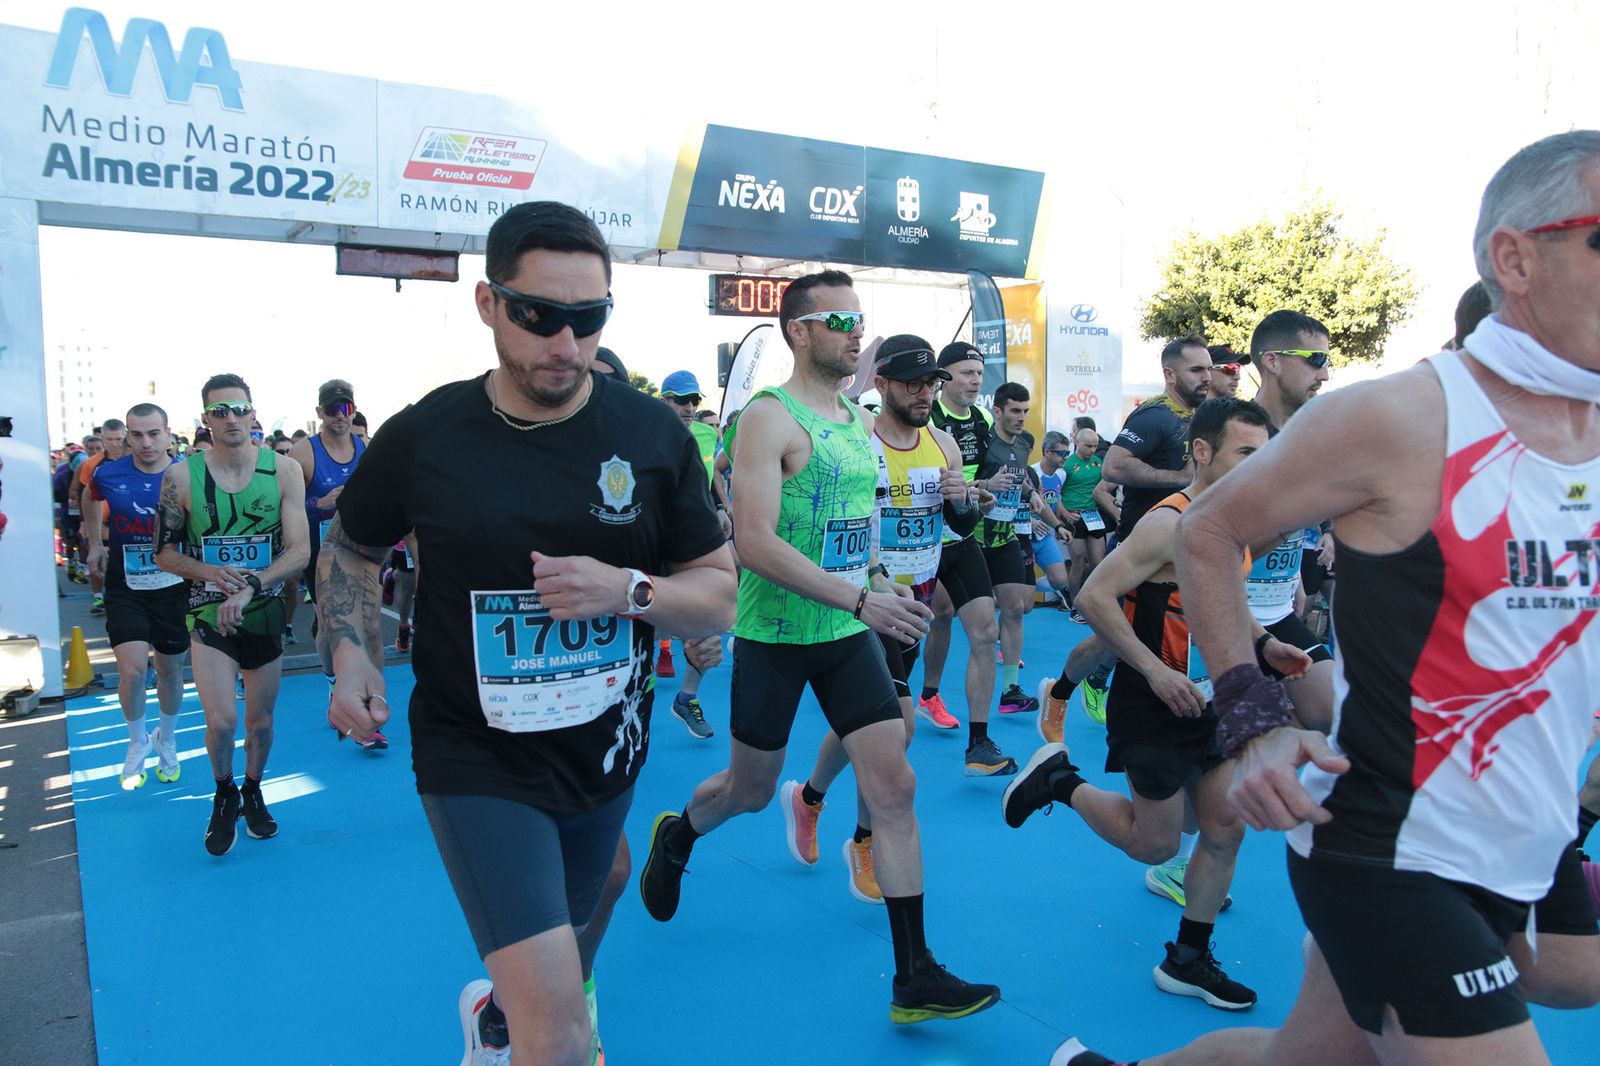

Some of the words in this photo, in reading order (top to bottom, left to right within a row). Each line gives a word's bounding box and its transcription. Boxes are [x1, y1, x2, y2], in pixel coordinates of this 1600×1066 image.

[42, 104, 166, 146] Medio
[186, 122, 336, 164] Maratón
[463, 155, 511, 167] RUNNING
[467, 147, 537, 162] ATLETISMO
[42, 143, 218, 192] Almería
[432, 167, 474, 182] Prueba
[476, 172, 513, 185] Oficial
[401, 193, 479, 215] RAMÓN
[718, 179, 786, 214] NEXA
[809, 185, 864, 217] CDX
[887, 224, 929, 239] ALMERÍA
[897, 236, 920, 245] CIUDAD
[1060, 325, 1109, 337] HYUNDAI
[1065, 365, 1102, 374] ESTRELLA
[1066, 389, 1099, 414] ego
[896, 517, 935, 538] 631
[218, 545, 258, 562] 630
[1266, 551, 1298, 570] 690
[1507, 540, 1600, 588] ULT
[494, 616, 618, 657] 1709
[511, 658, 546, 670] JOSE
[549, 651, 602, 667] MANUEL
